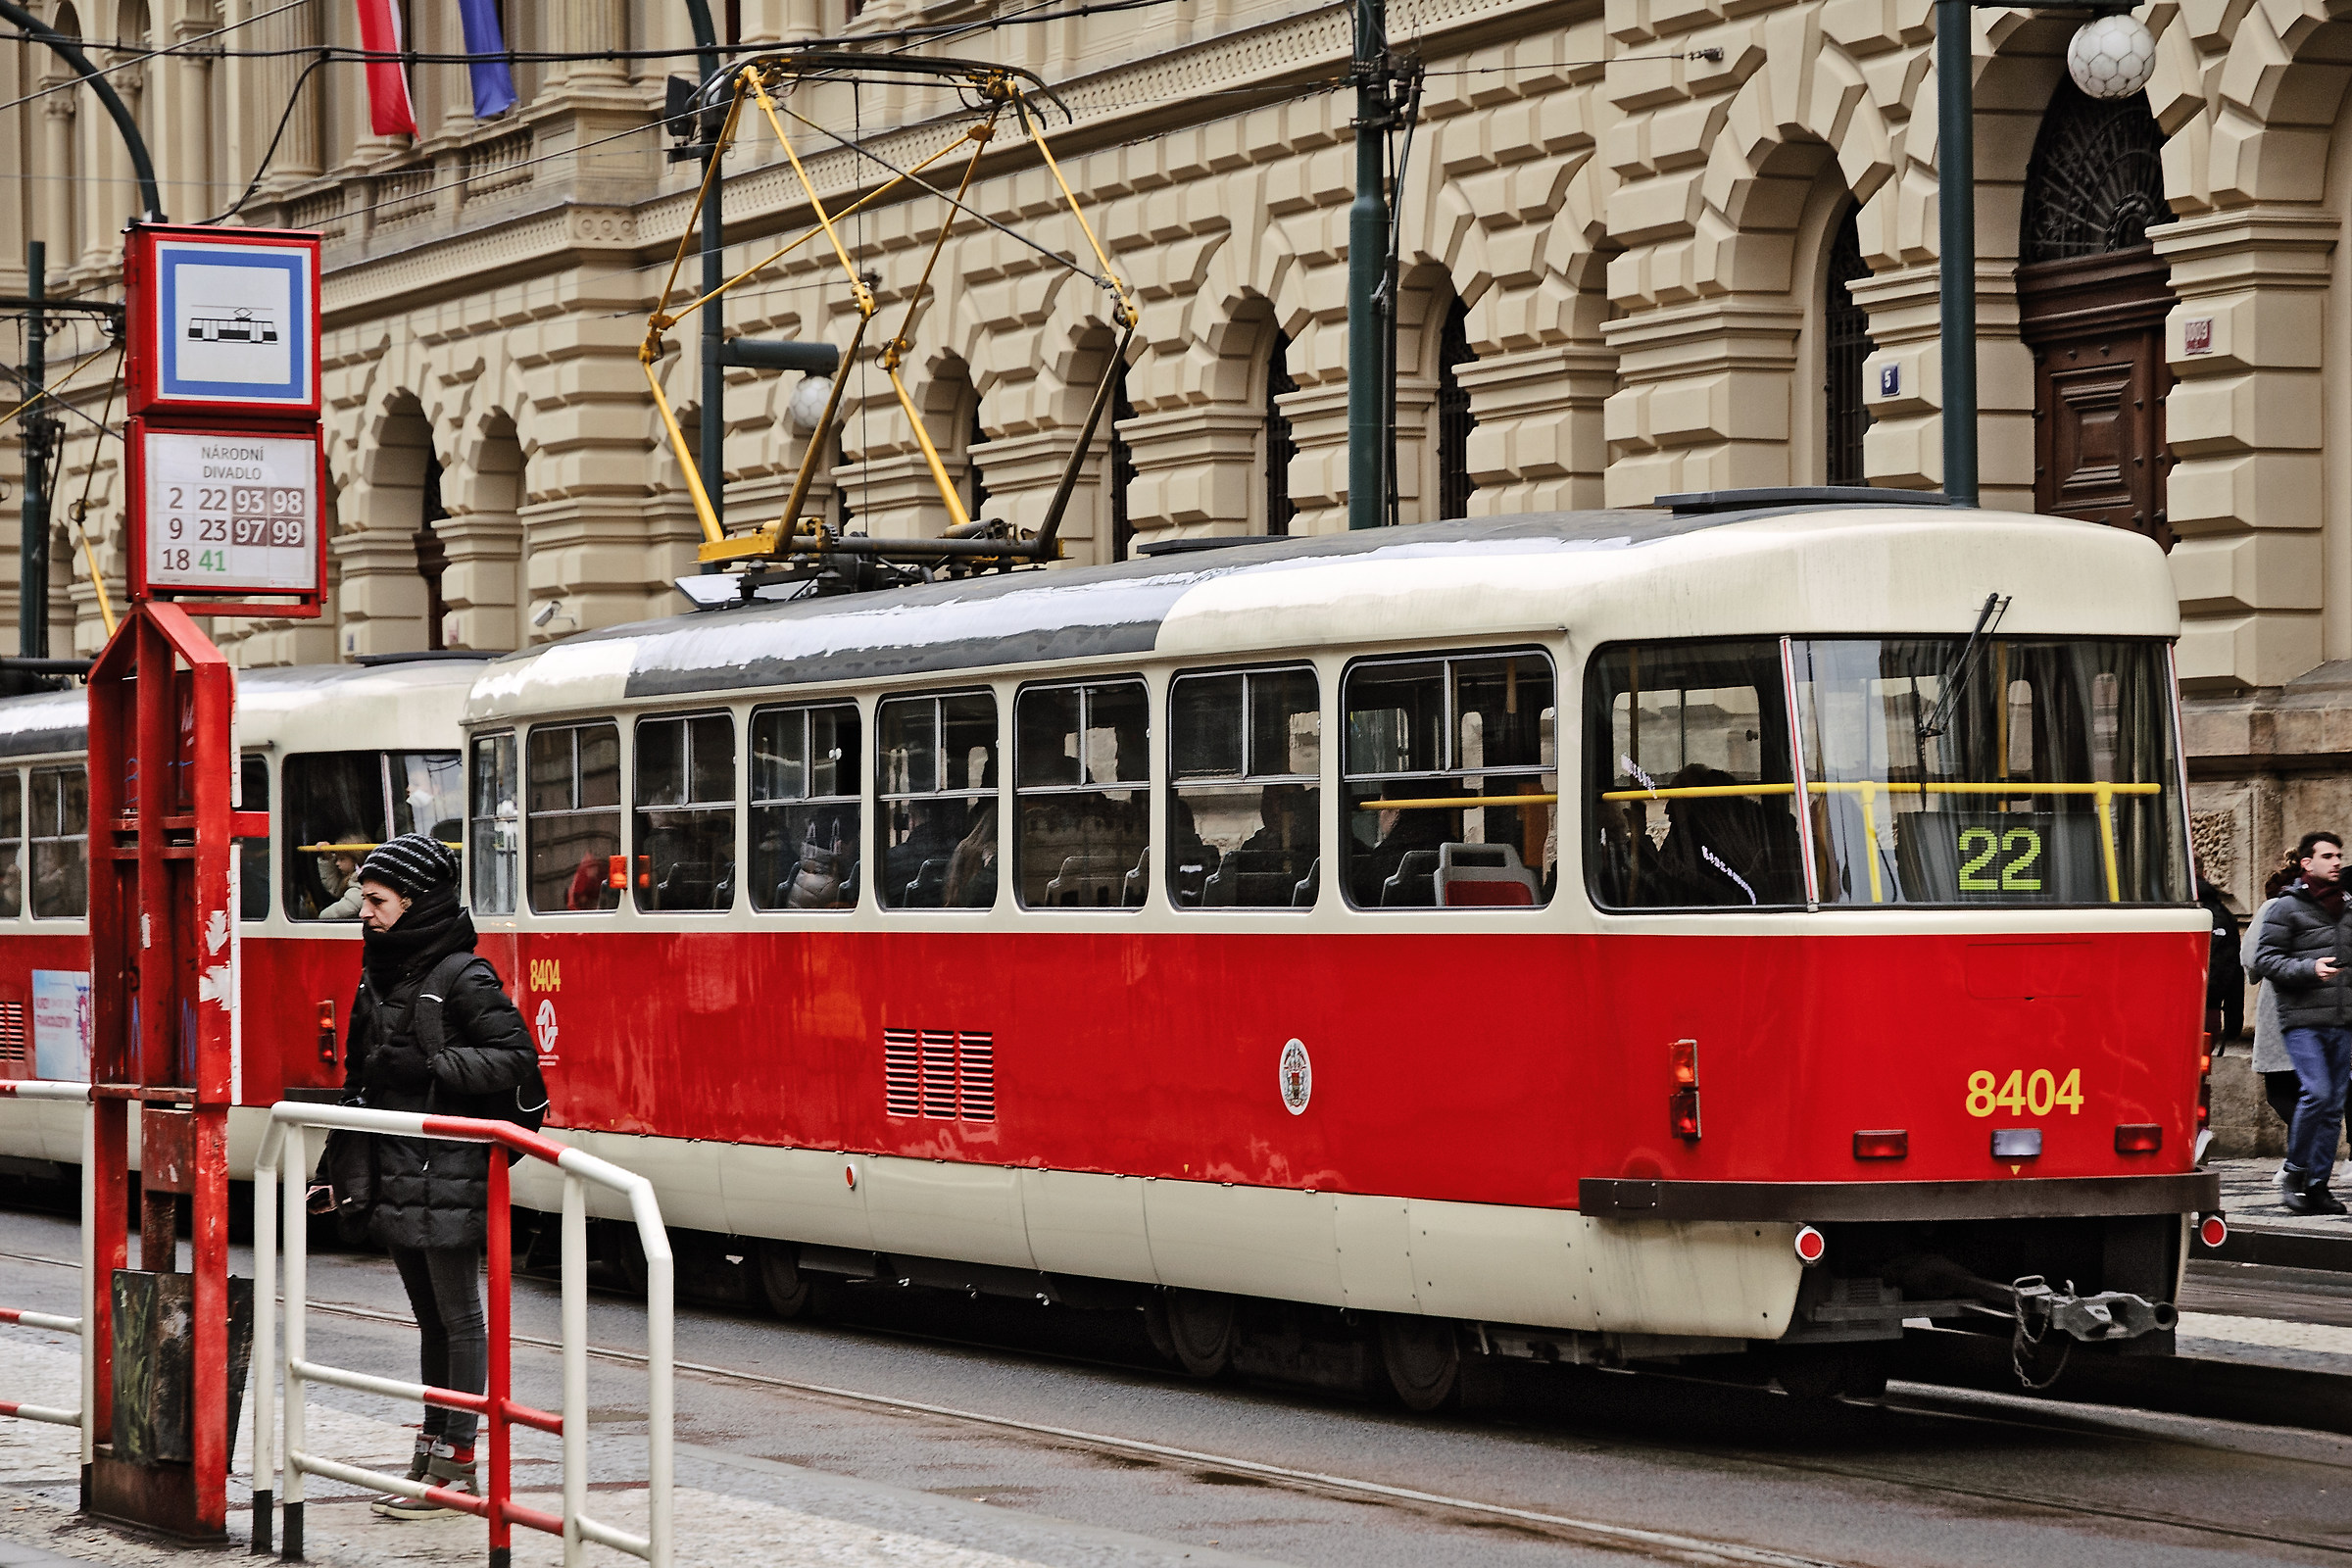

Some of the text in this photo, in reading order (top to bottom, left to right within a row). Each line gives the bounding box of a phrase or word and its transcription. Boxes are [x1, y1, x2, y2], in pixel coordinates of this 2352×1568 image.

[1884, 368, 1892, 389] 5
[201, 444, 265, 462] NÁRODNÍ
[203, 466, 262, 480] DIVADLO
[169, 487, 303, 514] 2 22 93 98
[170, 517, 303, 545] 9 23 97 99
[163, 549, 226, 572] 18 41
[1959, 827, 2041, 890] 22
[530, 958, 561, 992] 8404
[1965, 1068, 2084, 1117] 8404
